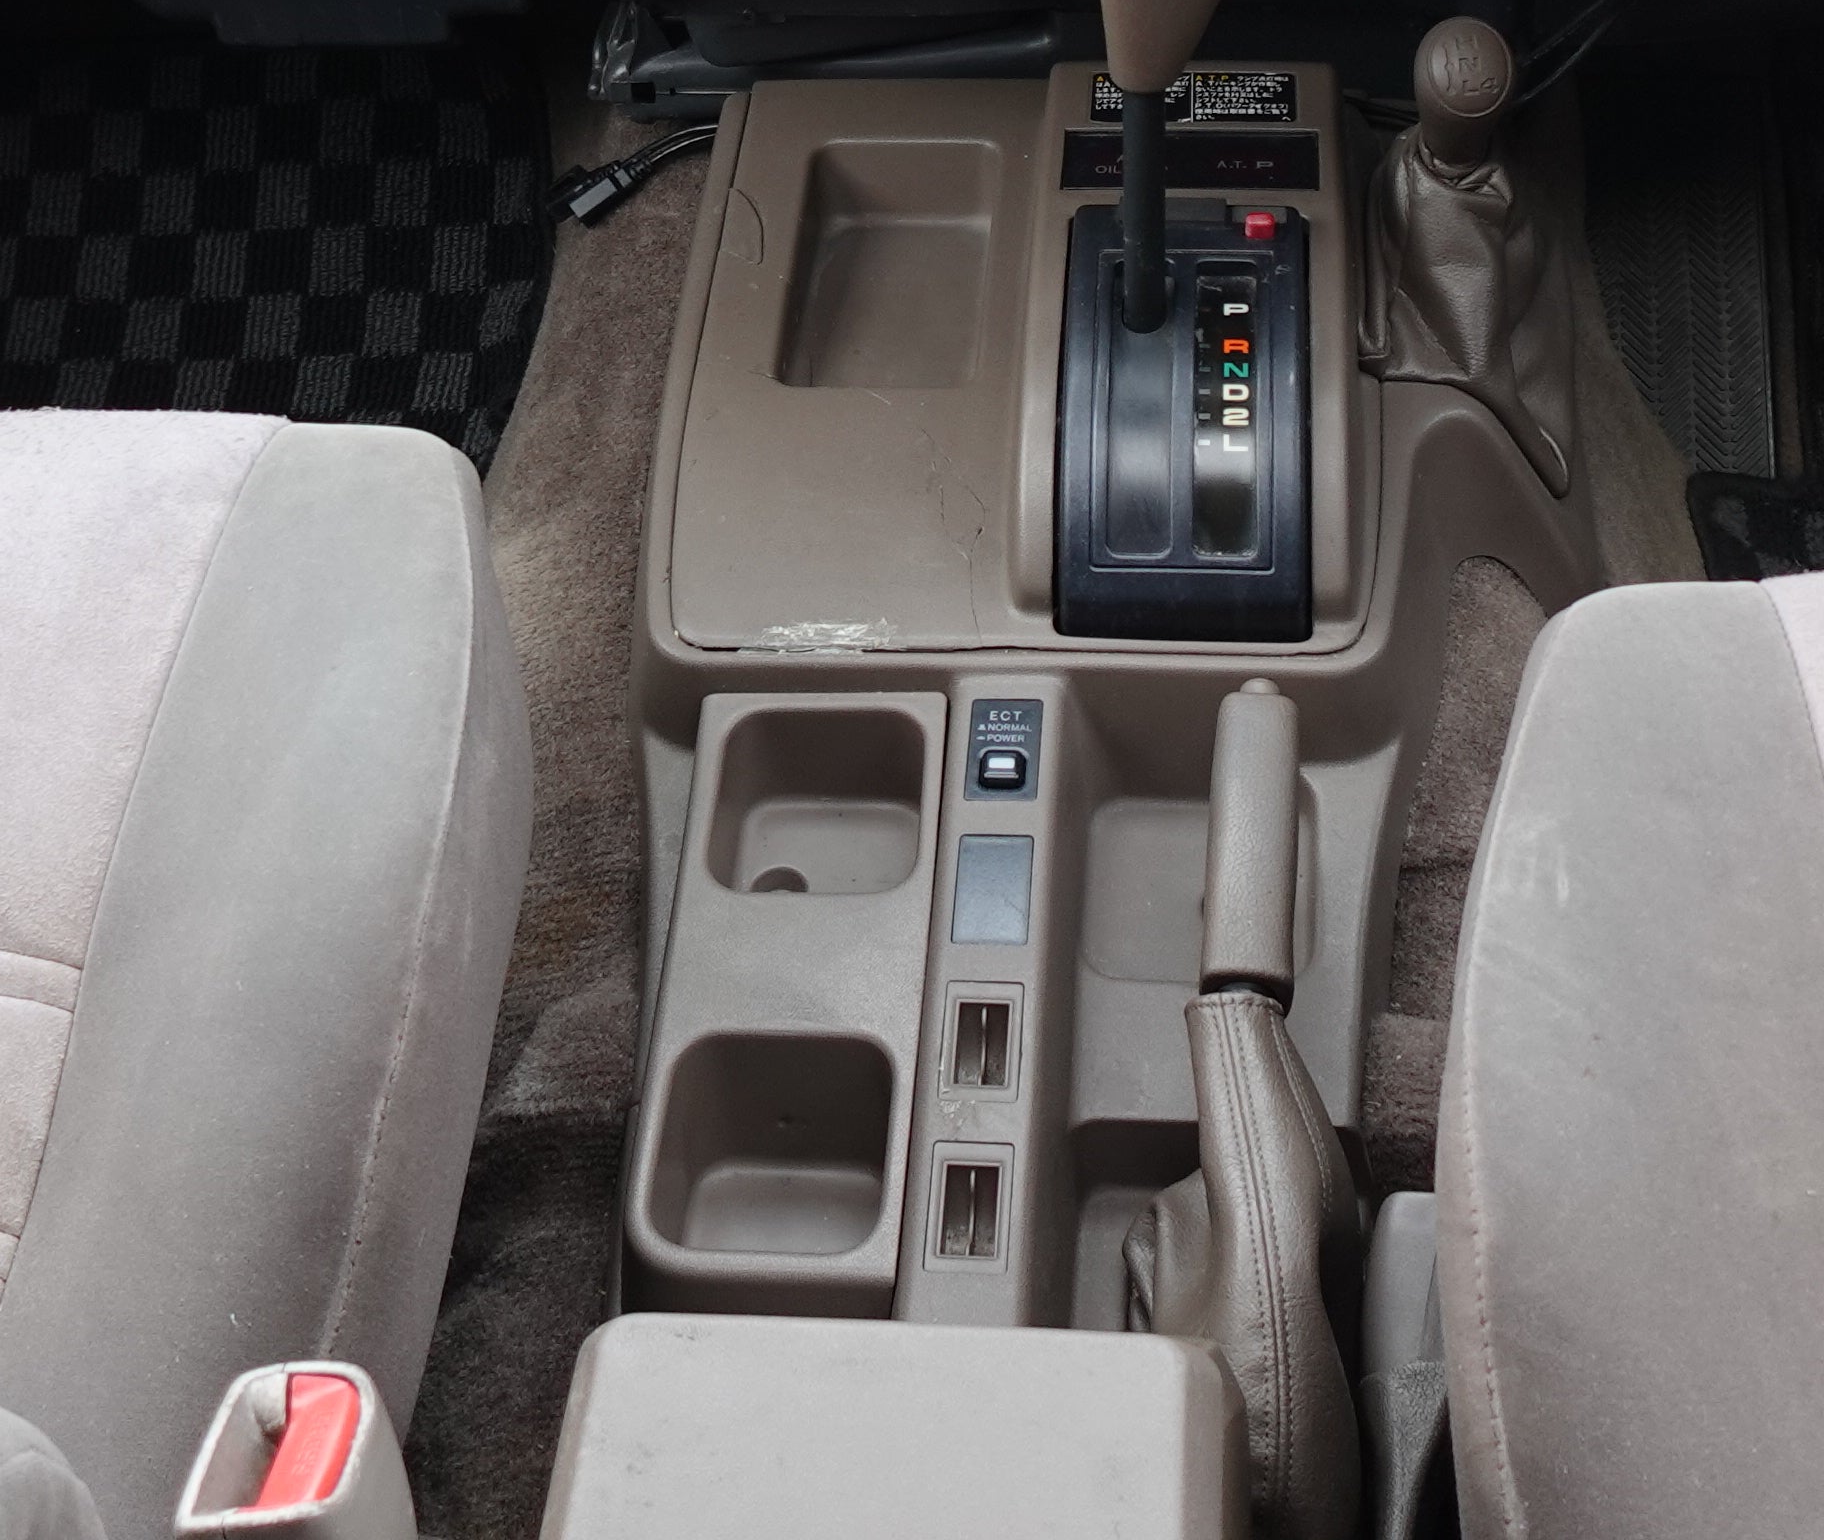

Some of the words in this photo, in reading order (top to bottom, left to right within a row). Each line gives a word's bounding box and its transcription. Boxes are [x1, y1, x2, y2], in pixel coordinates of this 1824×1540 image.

[1223, 303, 1249, 316] P
[1223, 339, 1250, 354] R
[1223, 362, 1249, 378] N
[1222, 383, 1249, 401] D
[1222, 407, 1249, 426] 2
[1223, 434, 1249, 452] L
[989, 710, 1023, 721] ECT
[987, 723, 1032, 732] NORMAL
[986, 733, 1025, 742] POWER
